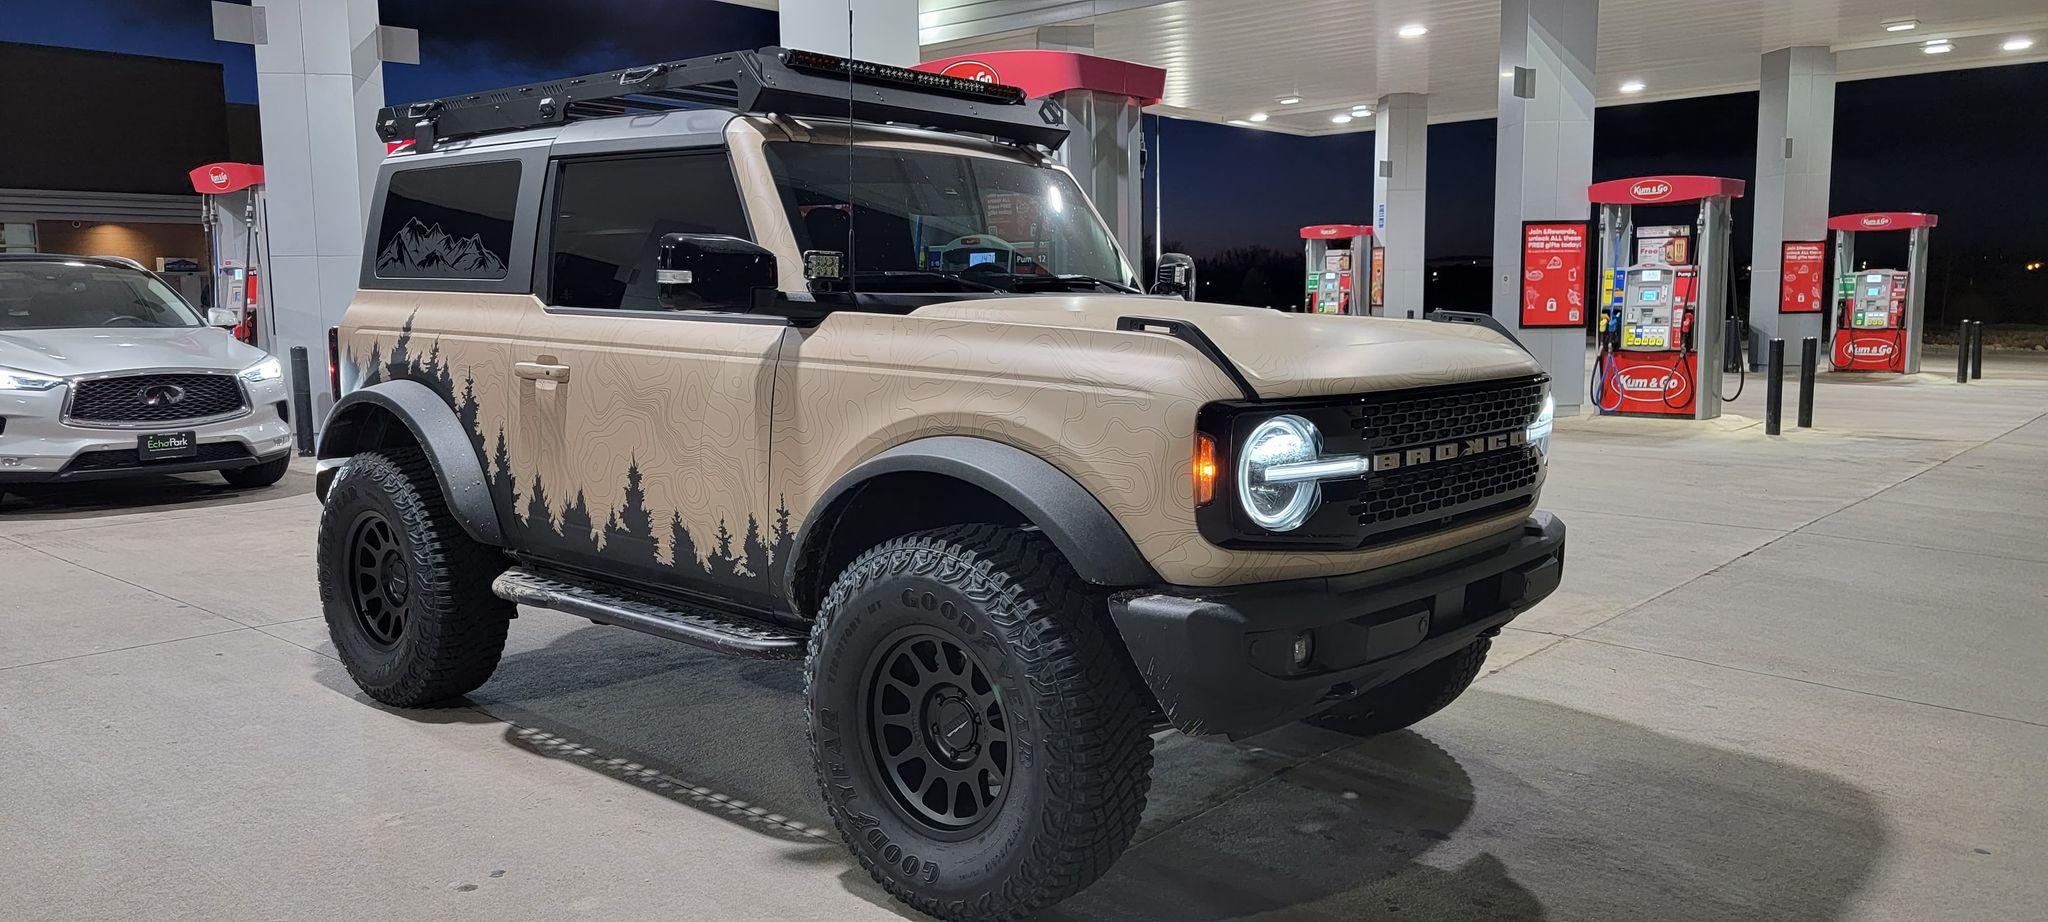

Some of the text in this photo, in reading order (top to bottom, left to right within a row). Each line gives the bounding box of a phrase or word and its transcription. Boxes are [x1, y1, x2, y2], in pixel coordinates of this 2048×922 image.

[1633, 185, 1651, 195] Kum
[1657, 184, 1669, 194] Go
[1880, 217, 1889, 225] Go
[1016, 254, 1046, 263] Pum 12
[1848, 344, 1893, 355] Kum & Go
[1618, 375, 1678, 390] Kum & Go
[147, 437, 188, 448] EchoPark
